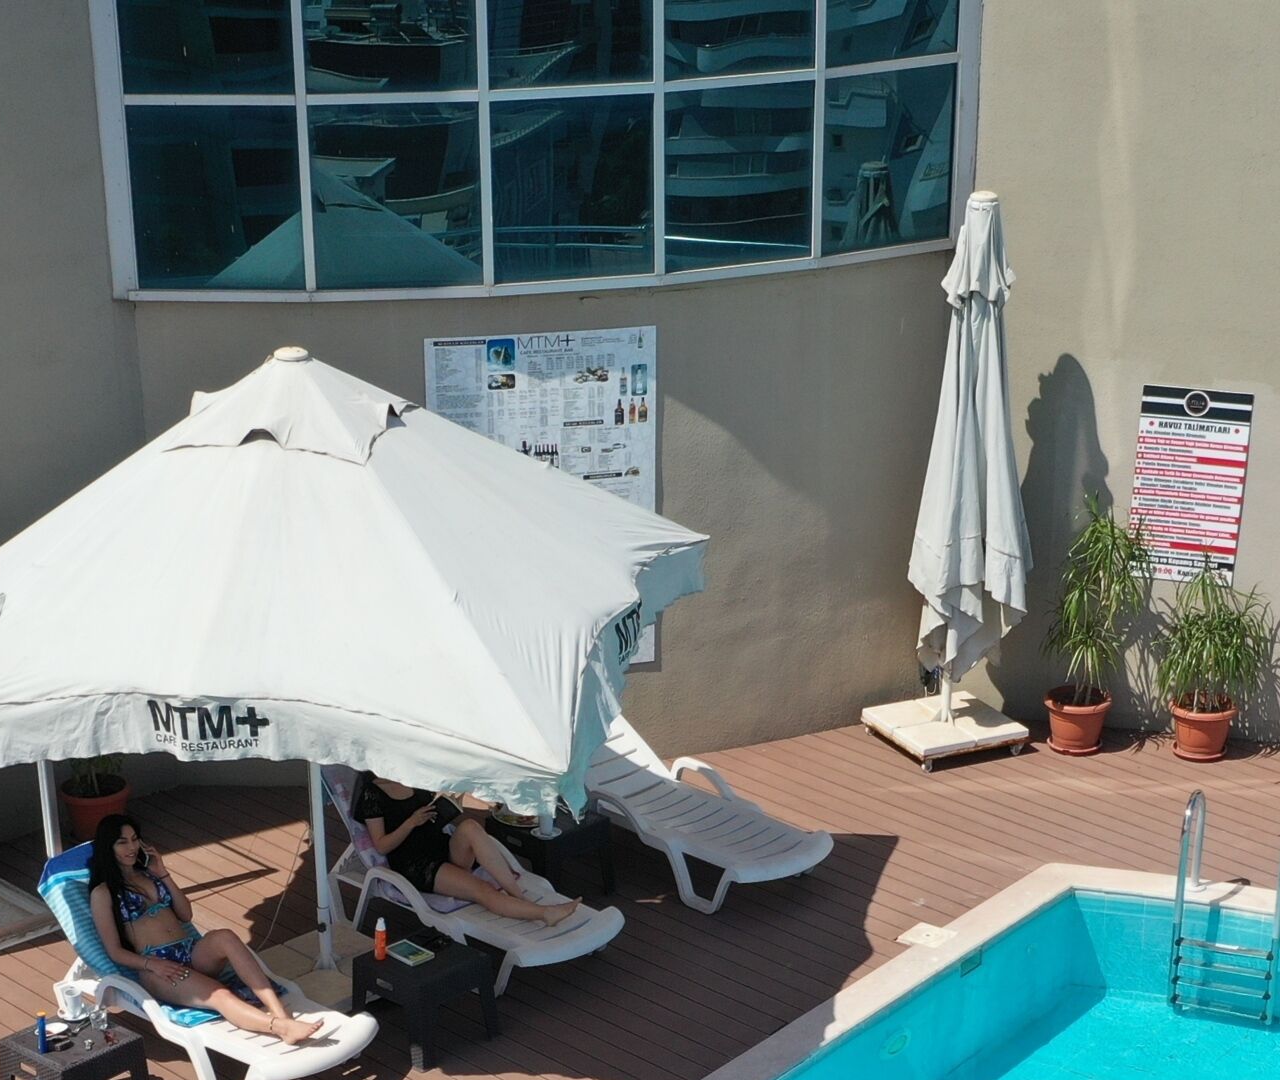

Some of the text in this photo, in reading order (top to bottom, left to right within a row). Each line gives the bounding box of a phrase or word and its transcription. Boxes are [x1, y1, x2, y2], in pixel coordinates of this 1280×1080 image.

[517, 334, 575, 349] MTM+
[1158, 421, 1183, 430] HAVUZ
[147, 699, 270, 740] MTM+
[181, 738, 259, 752] RESTAURANT
